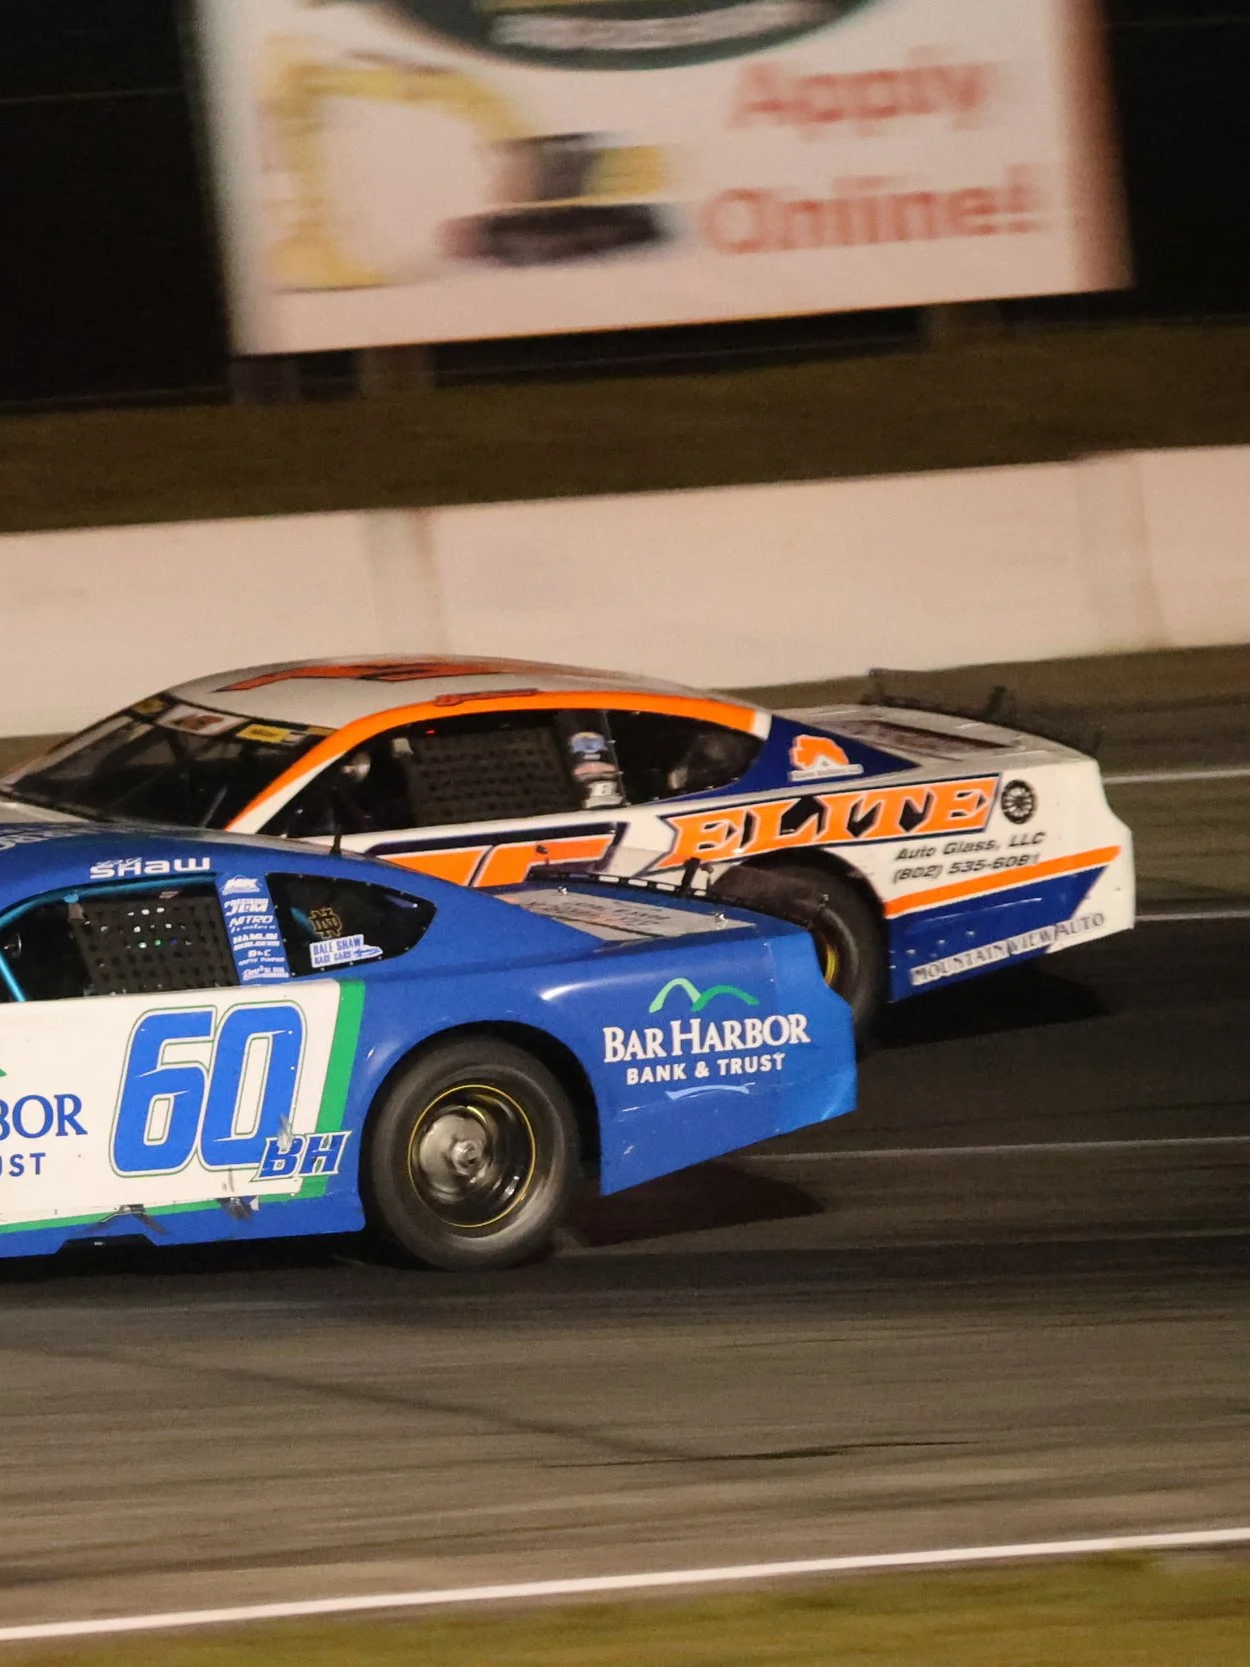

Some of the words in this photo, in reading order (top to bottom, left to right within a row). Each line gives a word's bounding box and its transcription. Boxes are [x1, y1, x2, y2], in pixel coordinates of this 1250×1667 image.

[728, 46, 990, 140] Apply
[697, 164, 1042, 254] Online!
[651, 778, 1000, 869] ELITE
[894, 845, 936, 861] Auto
[942, 839, 1001, 856] Glass,
[1008, 832, 1046, 847] LLC
[892, 864, 943, 884] (802)
[1055, 911, 1105, 937] AUTO
[602, 1026, 667, 1063] BAR
[670, 1013, 811, 1057] HARBOR
[110, 1001, 306, 1177] 60
[626, 1062, 687, 1086] BANK
[694, 1060, 710, 1078] &
[717, 1052, 786, 1076] TRUST
[250, 1131, 352, 1182] BH
